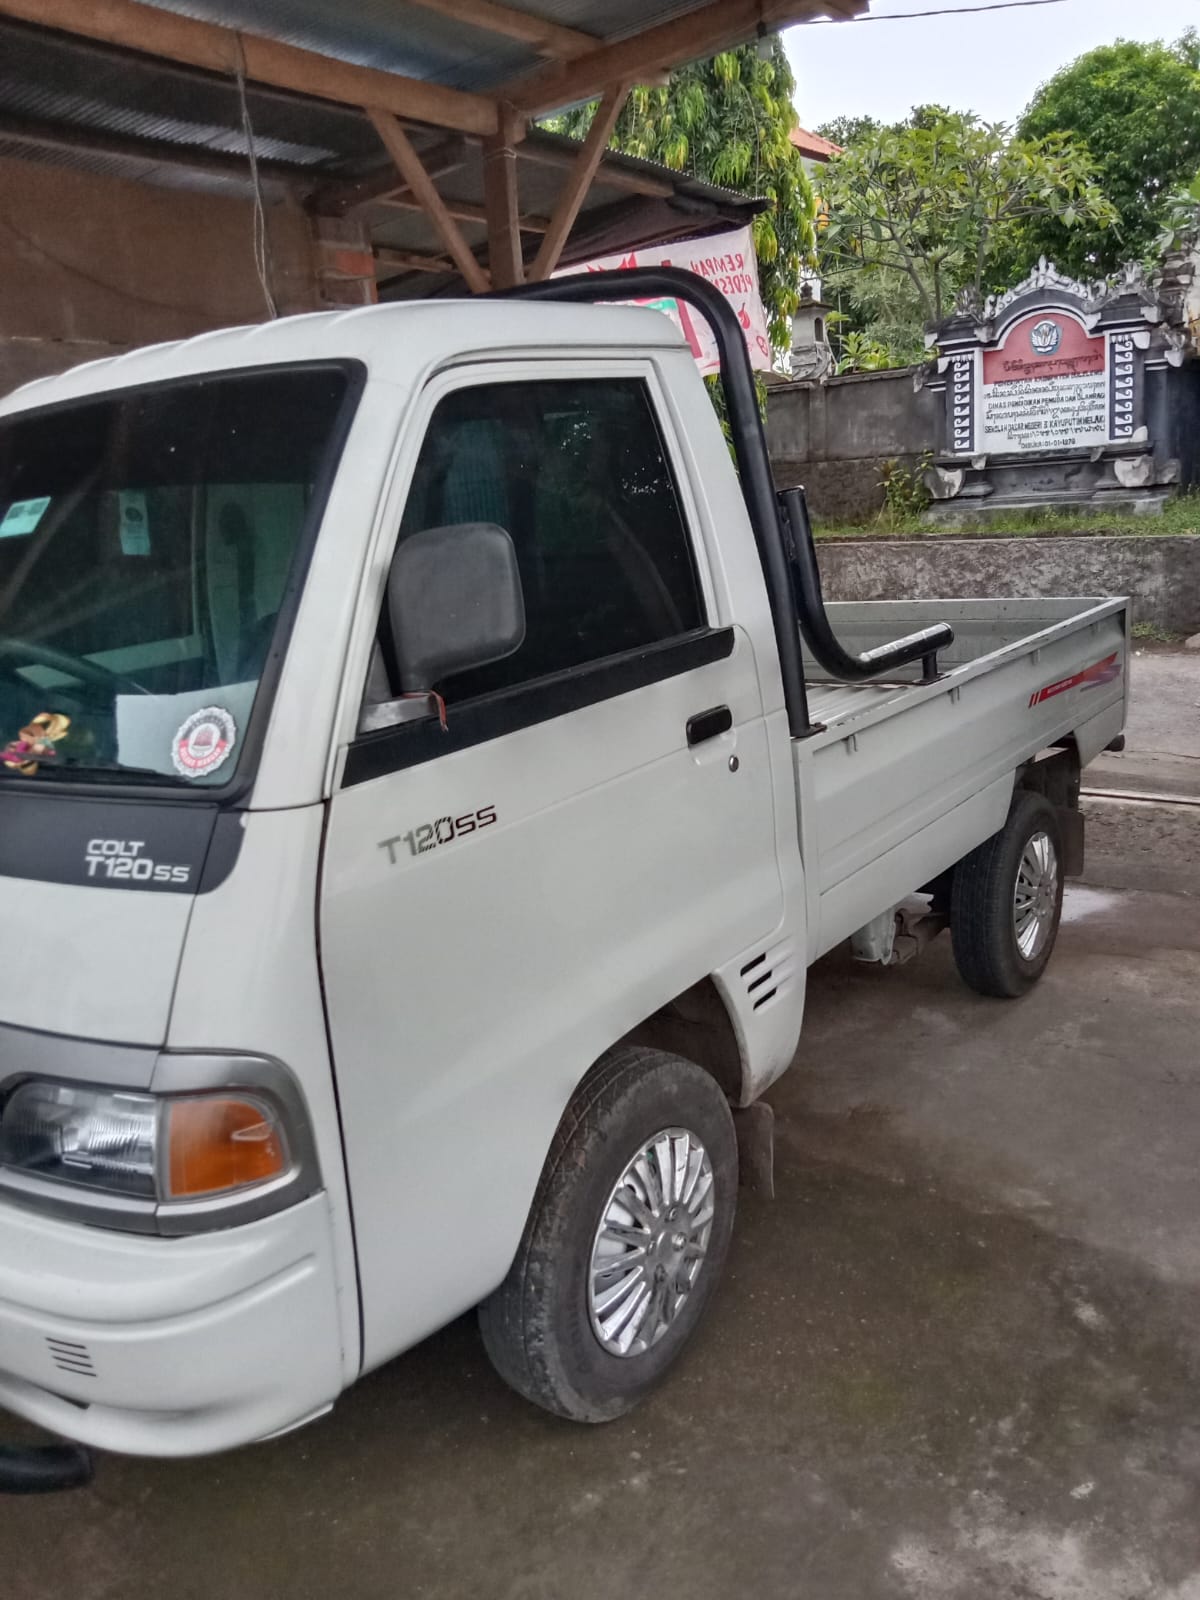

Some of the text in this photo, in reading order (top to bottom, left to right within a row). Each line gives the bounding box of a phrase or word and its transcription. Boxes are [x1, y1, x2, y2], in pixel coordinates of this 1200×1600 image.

[87, 839, 145, 857] COLT
[376, 804, 497, 865] T120SS
[85, 855, 191, 883] T120SS
